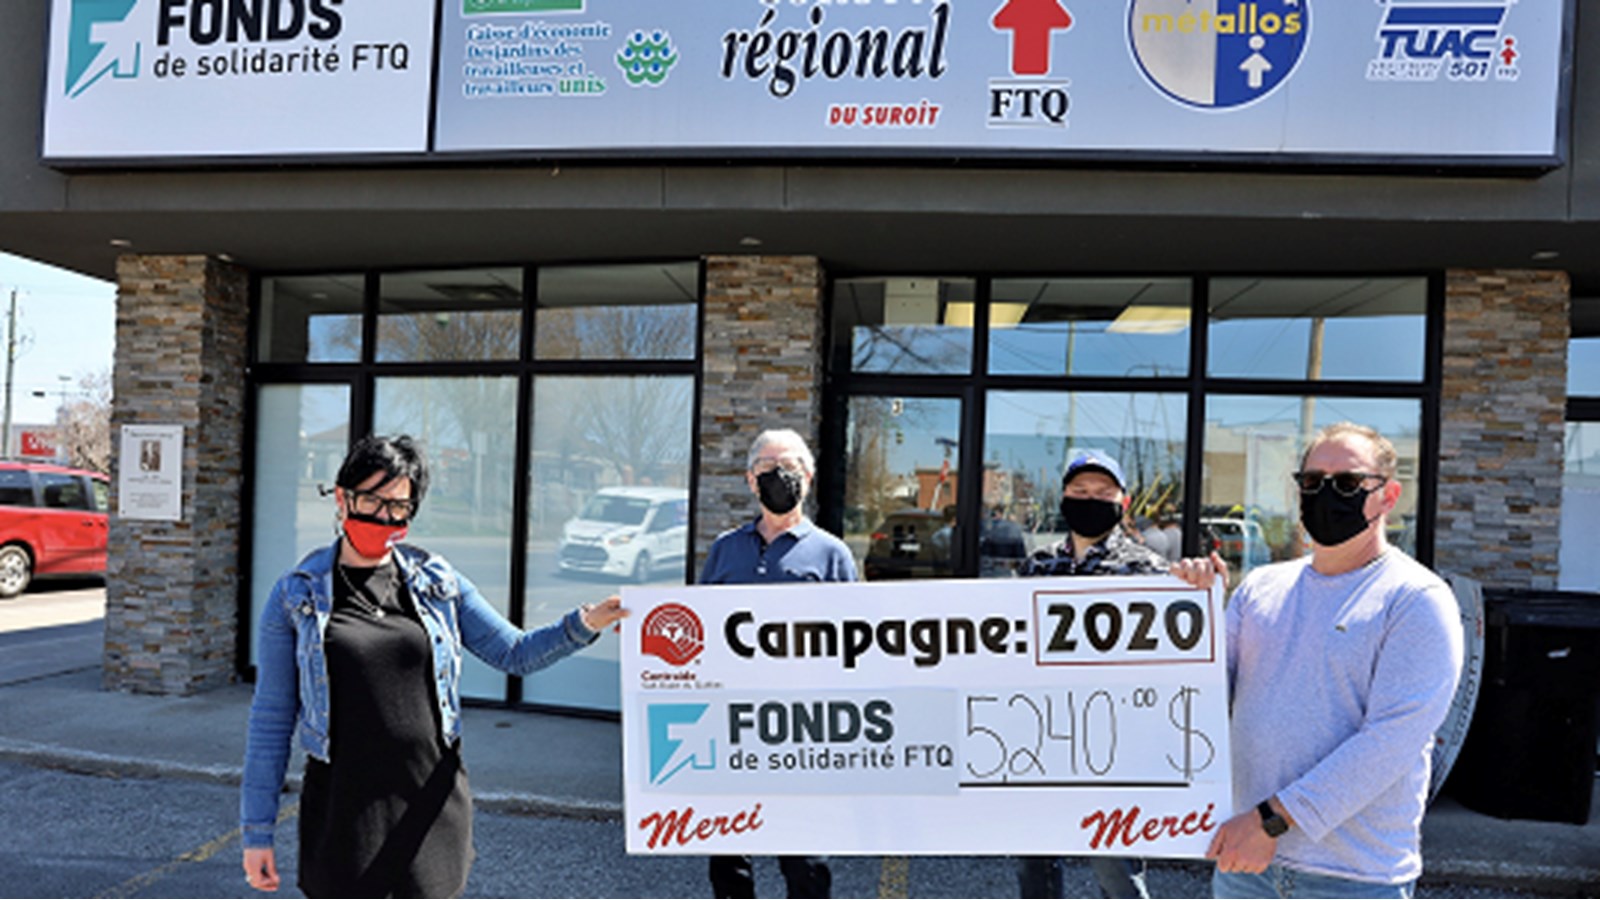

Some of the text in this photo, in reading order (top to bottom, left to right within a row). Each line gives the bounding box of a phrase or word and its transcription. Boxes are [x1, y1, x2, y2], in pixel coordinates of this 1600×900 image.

[157, 0, 343, 46] FONDS
[1142, 3, 1302, 34] métallos
[154, 44, 410, 77] de solidarité FTQ
[722, 2, 949, 98] régional
[1380, 29, 1497, 58] TUAC
[558, 75, 606, 94] unis
[1450, 61, 1489, 77] 501
[829, 105, 858, 125] DU
[990, 88, 1069, 123] FTQ
[724, 600, 1204, 668] Campagne: 2020
[728, 700, 894, 744] FONDS
[1166, 686, 1215, 781] $
[729, 745, 954, 770] de solidarité FTQ
[639, 803, 764, 850] Merci
[1081, 803, 1217, 850] Merci
